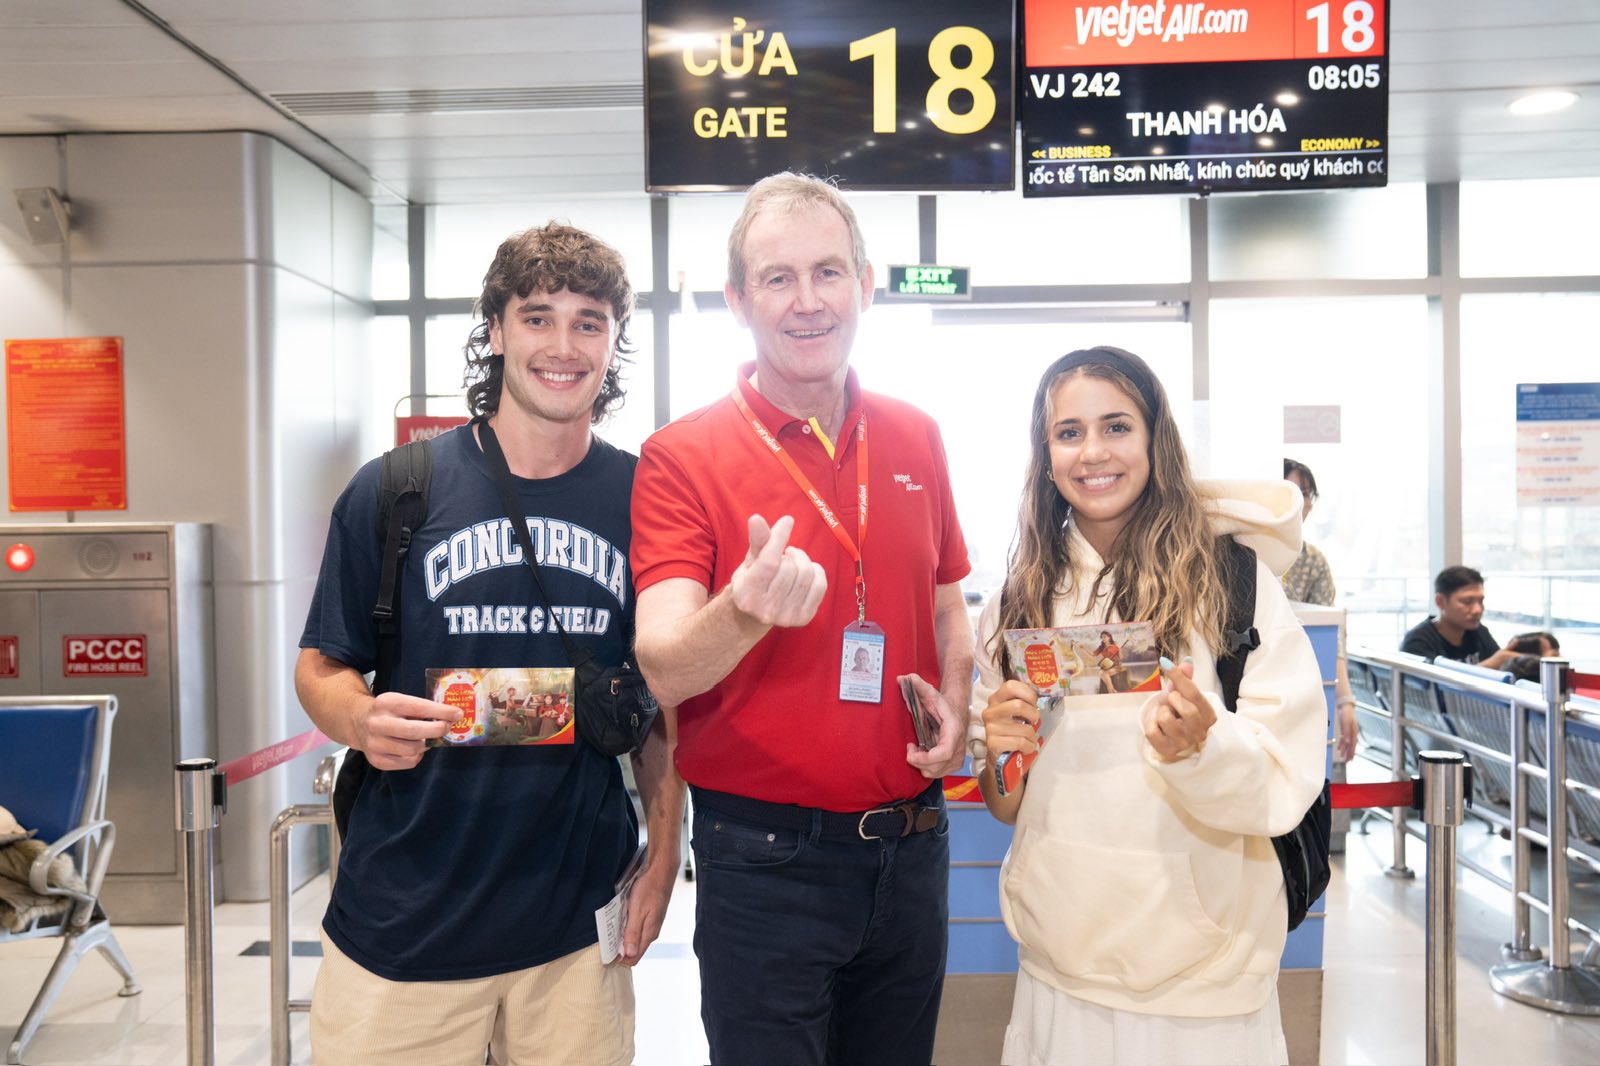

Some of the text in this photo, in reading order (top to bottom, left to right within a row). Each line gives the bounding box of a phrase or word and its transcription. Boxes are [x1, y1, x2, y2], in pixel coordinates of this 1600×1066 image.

[1306, 0, 1375, 53] 18
[683, 17, 798, 77] CỬA
[850, 26, 996, 135] 18
[1030, 72, 1121, 98] VJ 242
[1308, 64, 1380, 90] 08:05
[693, 107, 787, 138] GATE
[1126, 103, 1287, 138] THANH HÓA
[1048, 145, 1112, 159] BUSINESS
[1301, 138, 1364, 151] ECONOMY
[1057, 164, 1076, 183] tế
[1078, 164, 1110, 182] Tân
[1113, 164, 1146, 182] Sơn
[1150, 161, 1194, 182] Nhất,
[1197, 161, 1232, 180] kính
[1236, 160, 1277, 178] chúc
[1280, 158, 1311, 180] quý
[1313, 156, 1363, 176] khách
[905, 267, 952, 282] EXIT
[424, 516, 627, 611] CONCORDIA
[443, 605, 528, 634] TRACK
[547, 606, 611, 635] FIELD
[69, 639, 142, 660] PCCC
[68, 662, 143, 673] FIRE HOSE REEL
